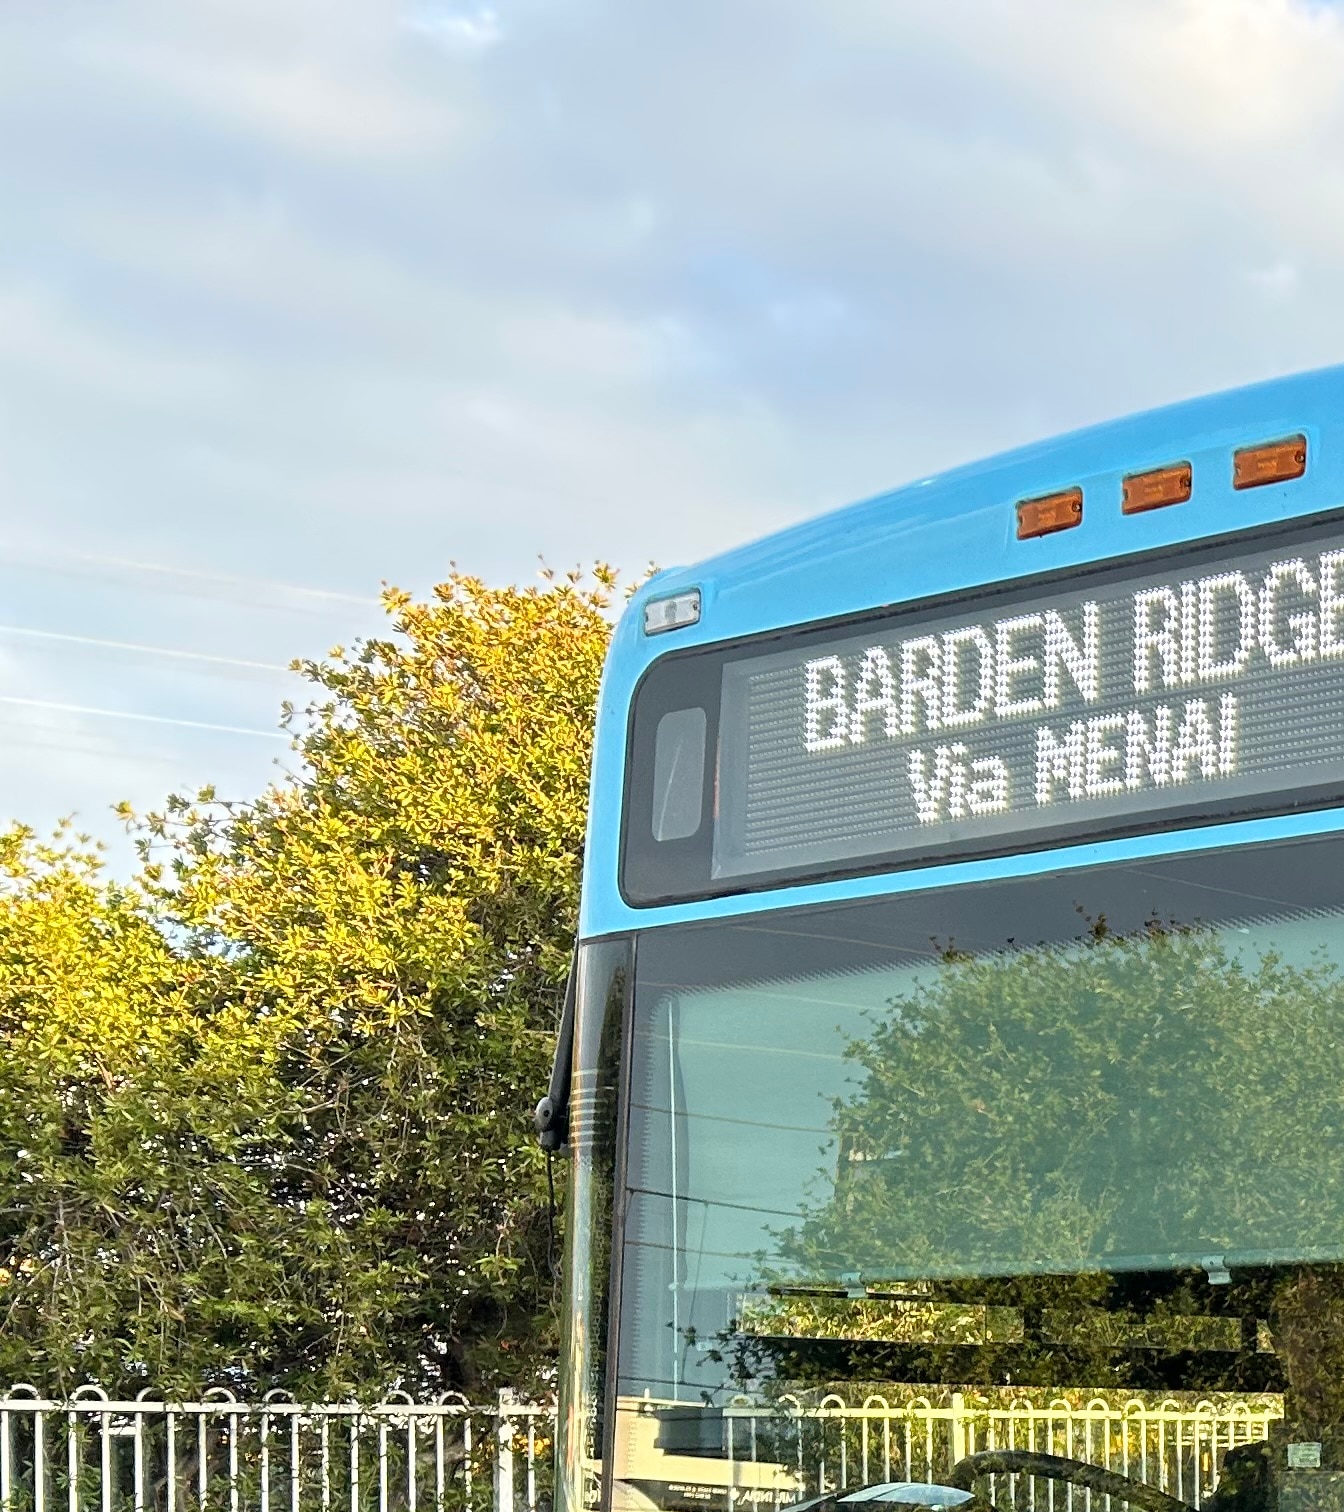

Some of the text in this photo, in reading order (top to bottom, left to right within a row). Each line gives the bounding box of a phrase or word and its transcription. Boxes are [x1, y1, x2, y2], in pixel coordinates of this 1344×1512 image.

[803, 600, 1099, 752] BARDEN
[907, 692, 1239, 826] Via MENAI
